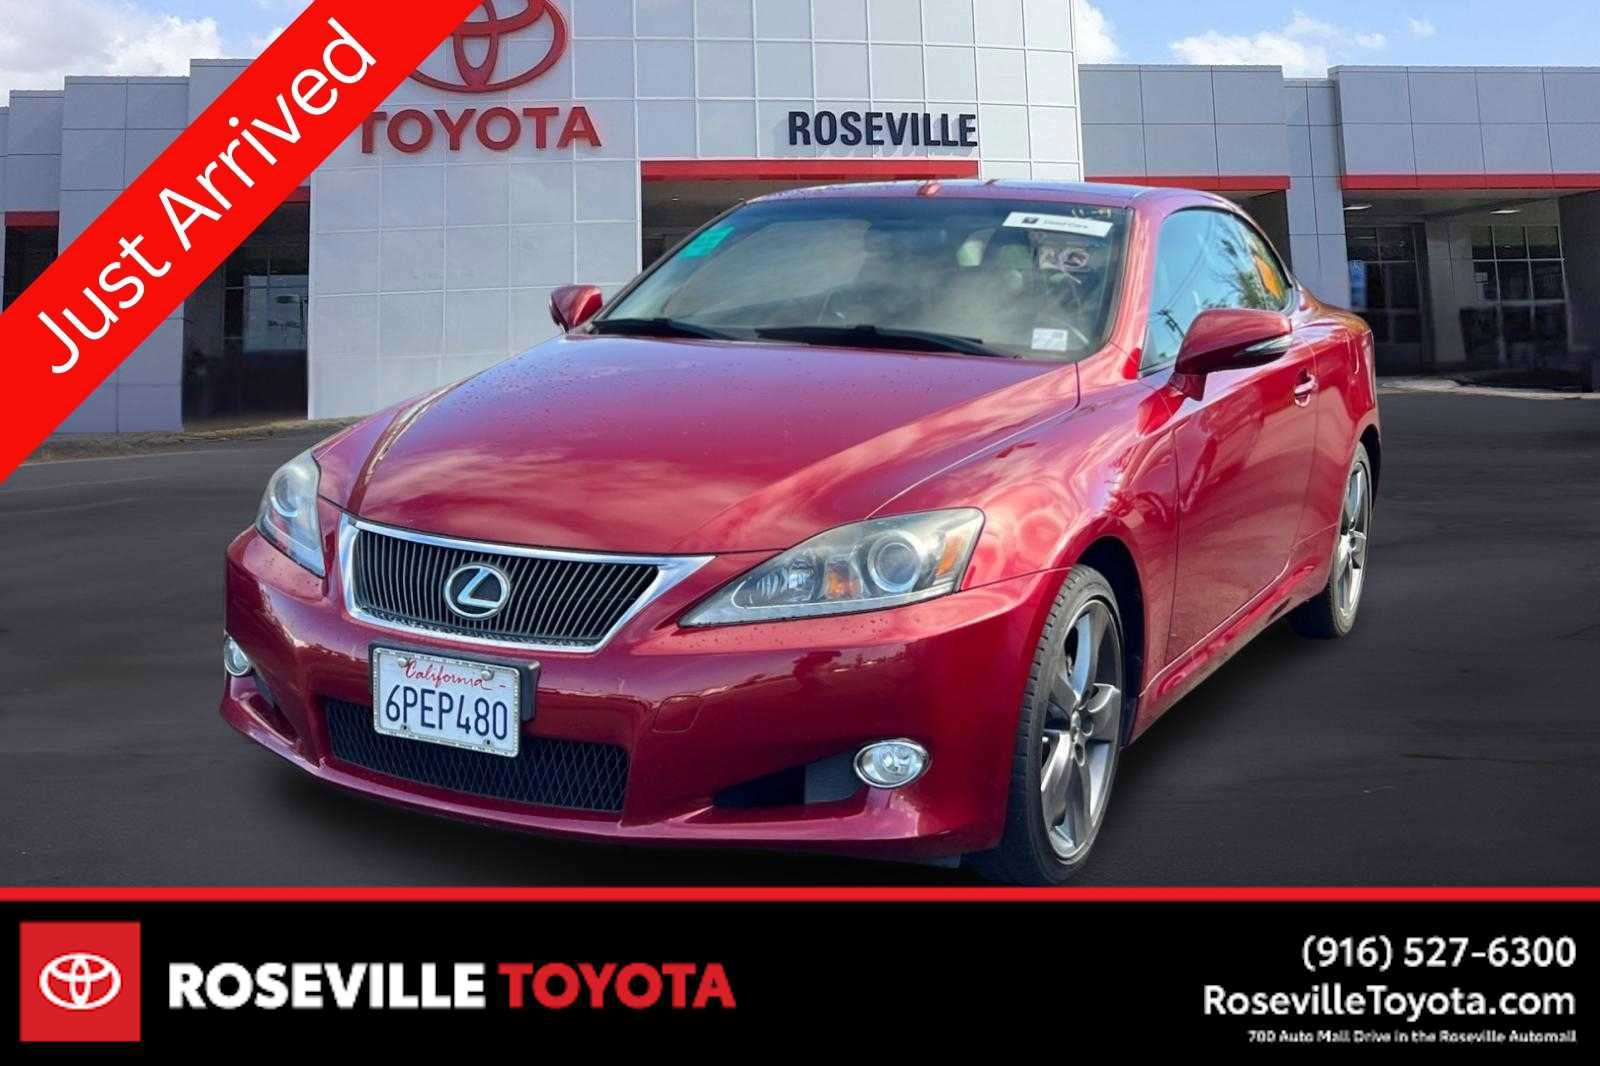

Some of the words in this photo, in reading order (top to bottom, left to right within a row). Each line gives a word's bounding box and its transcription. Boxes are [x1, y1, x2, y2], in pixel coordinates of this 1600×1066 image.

[361, 106, 602, 154] TOYOTA
[788, 111, 978, 147] ROSEVILLE
[404, 657, 493, 691] California
[385, 684, 508, 741] 6PEP480
